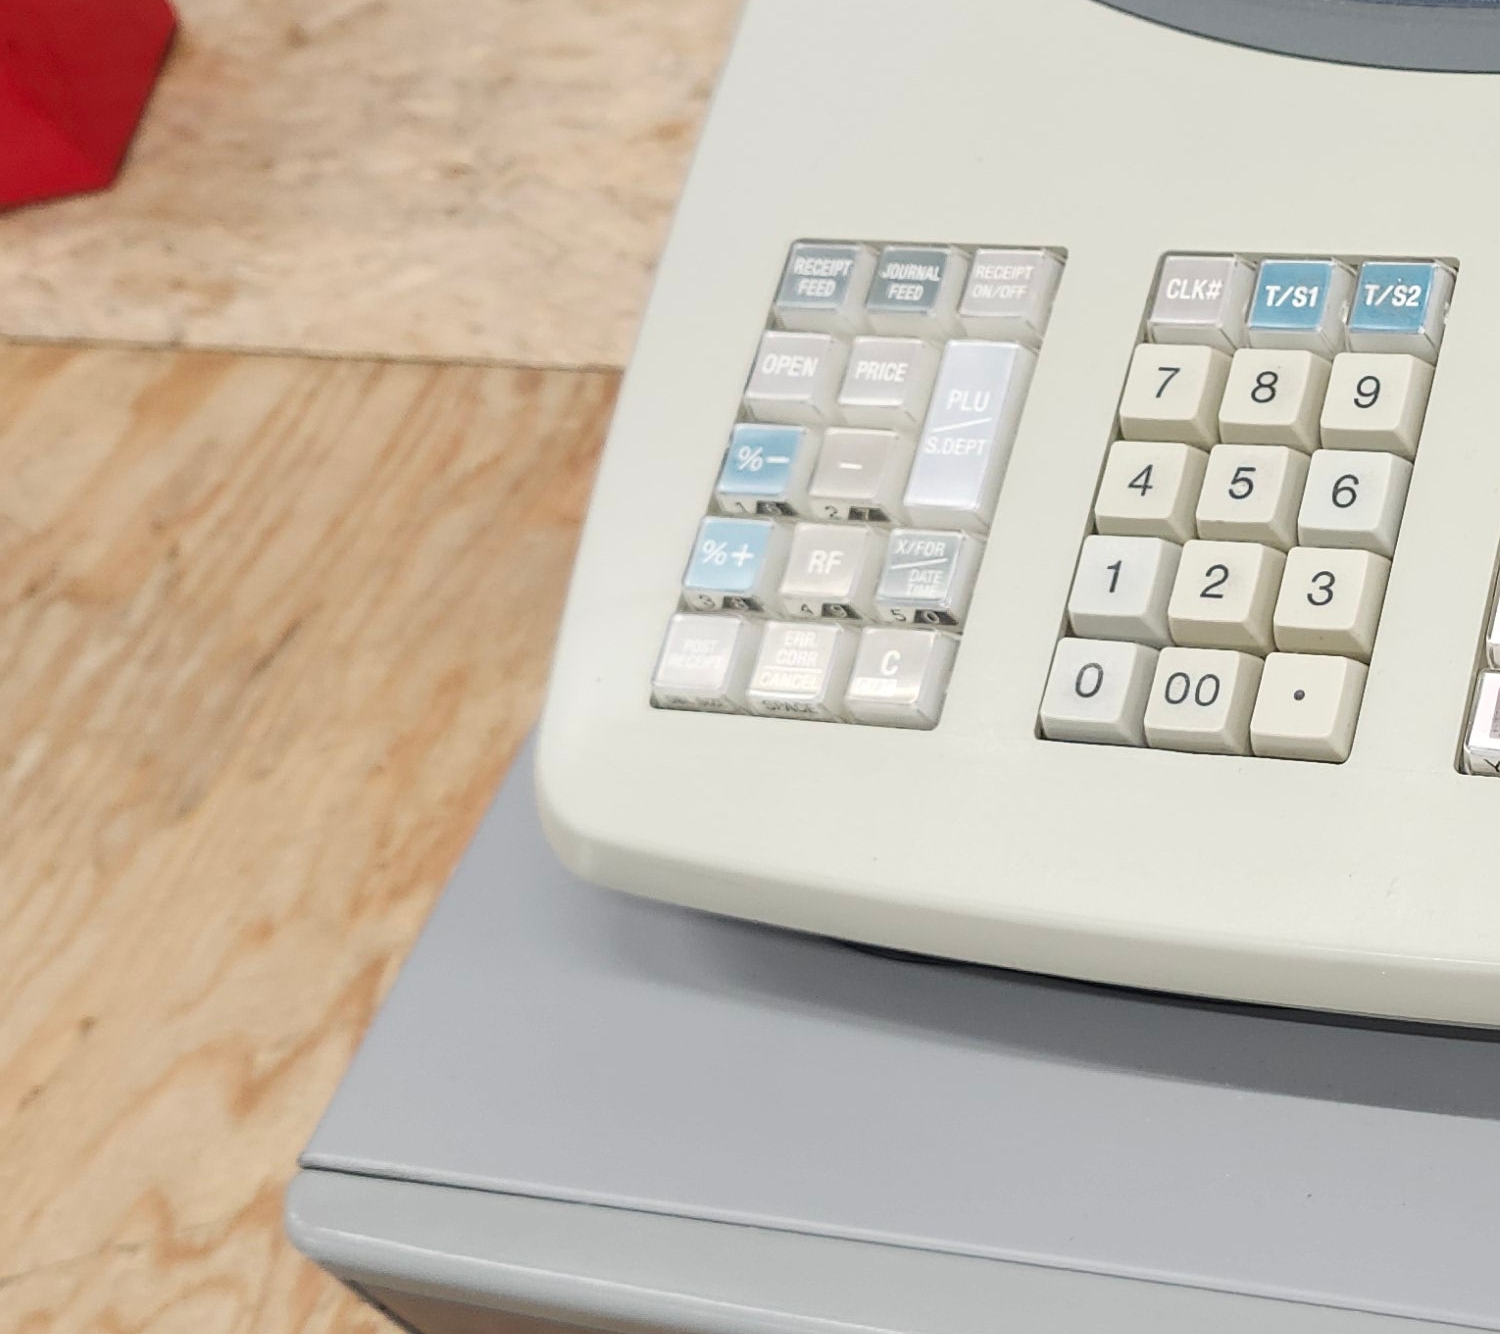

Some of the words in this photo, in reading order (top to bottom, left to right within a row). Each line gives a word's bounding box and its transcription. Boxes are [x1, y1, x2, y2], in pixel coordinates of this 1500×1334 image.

[793, 258, 852, 278] RECEIPT
[879, 264, 941, 282] JOURNAL
[975, 264, 1035, 282] RECEIPT
[797, 279, 835, 298] FEED
[887, 283, 925, 301] FEED
[972, 283, 1027, 300] ON/OFF
[1166, 277, 1222, 301] CLK#
[1265, 286, 1318, 307] T/S1
[1365, 284, 1421, 307] T/S2
[761, 353, 819, 378] OPEN
[854, 359, 907, 383] PRICE
[1155, 367, 1180, 398] 7
[1250, 370, 1279, 403] 8
[1352, 375, 1381, 408] 9
[946, 389, 989, 412] PLU
[925, 436, 989, 456] S.DEPT
[1128, 464, 1154, 496] 4
[1227, 467, 1256, 499] 5
[1331, 475, 1359, 508] 6
[895, 540, 946, 558] X/FOR
[807, 549, 844, 575] RF
[909, 568, 943, 585] DATE
[1106, 560, 1123, 593] 1
[1199, 564, 1229, 599] 2
[1306, 571, 1336, 606] 3
[776, 649, 818, 667] CORR
[882, 650, 900, 676] C
[1074, 663, 1104, 699] 0
[1163, 671, 1221, 706] 00
